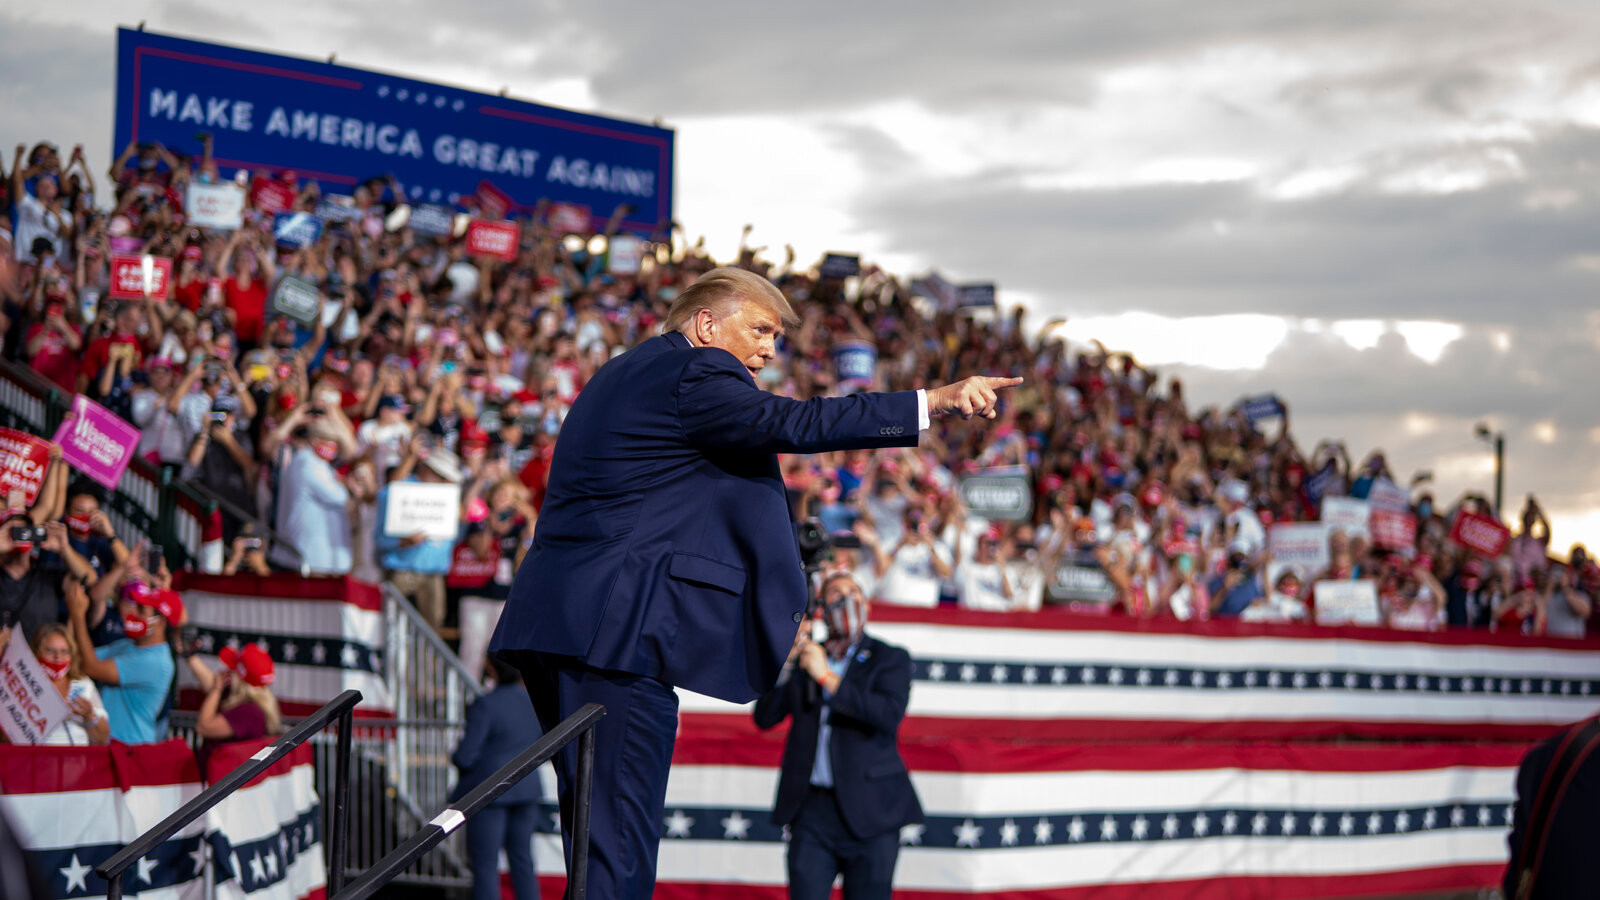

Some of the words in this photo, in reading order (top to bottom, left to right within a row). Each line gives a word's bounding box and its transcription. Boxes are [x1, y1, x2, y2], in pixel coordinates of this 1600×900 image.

[150, 87, 253, 132] MAKE
[264, 106, 424, 159] AMERICA
[433, 134, 541, 178] GREAT
[546, 155, 655, 198] AGAIN!
[0, 449, 43, 480] ERICA
[0, 661, 48, 735] MERICA
[16, 658, 43, 697] MAKE
